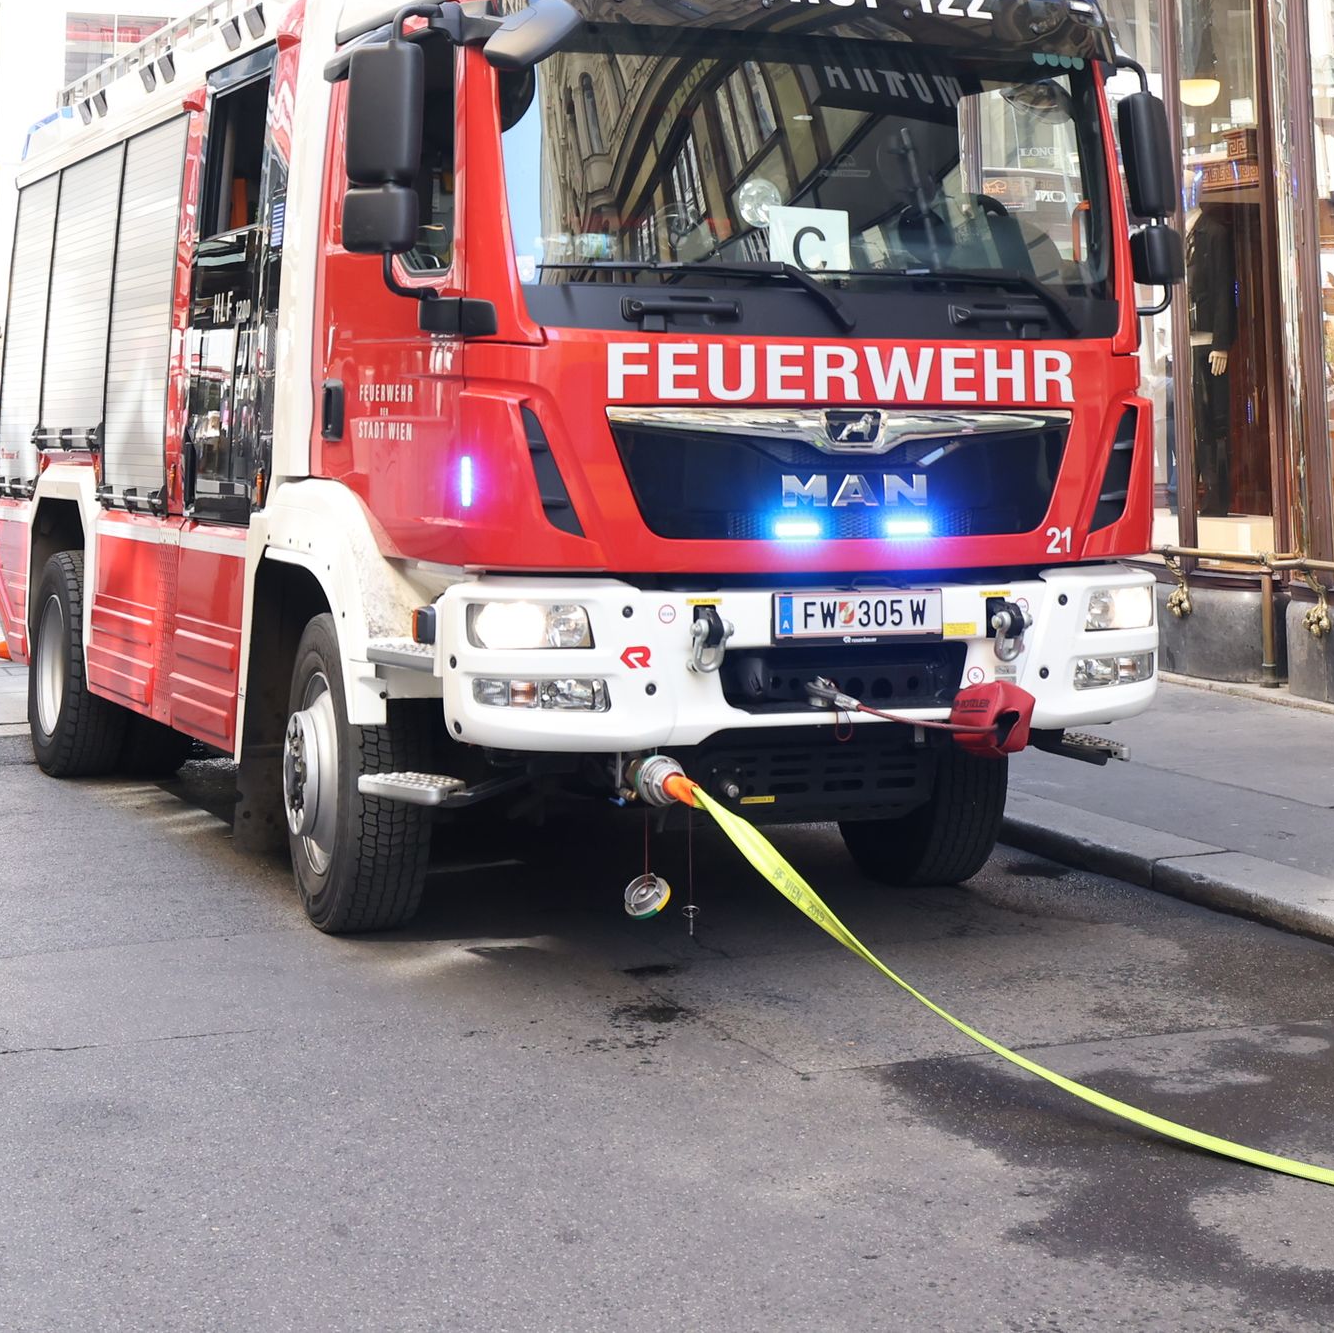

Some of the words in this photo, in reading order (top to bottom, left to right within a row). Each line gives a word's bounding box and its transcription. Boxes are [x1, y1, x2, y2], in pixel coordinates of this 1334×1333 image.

[792, 226, 828, 271] C
[213, 291, 234, 324] HLF
[235, 299, 251, 320] 1200
[606, 342, 1075, 403] FEUERWEHR
[359, 383, 413, 403] FEUERWEHR
[358, 420, 385, 439] STADT
[388, 421, 412, 441] WIEN
[780, 473, 928, 508] MAN
[1045, 526, 1072, 554] 21
[781, 620, 790, 630] A
[803, 600, 837, 630] FW
[858, 599, 903, 627] 305
[909, 598, 927, 619] W
